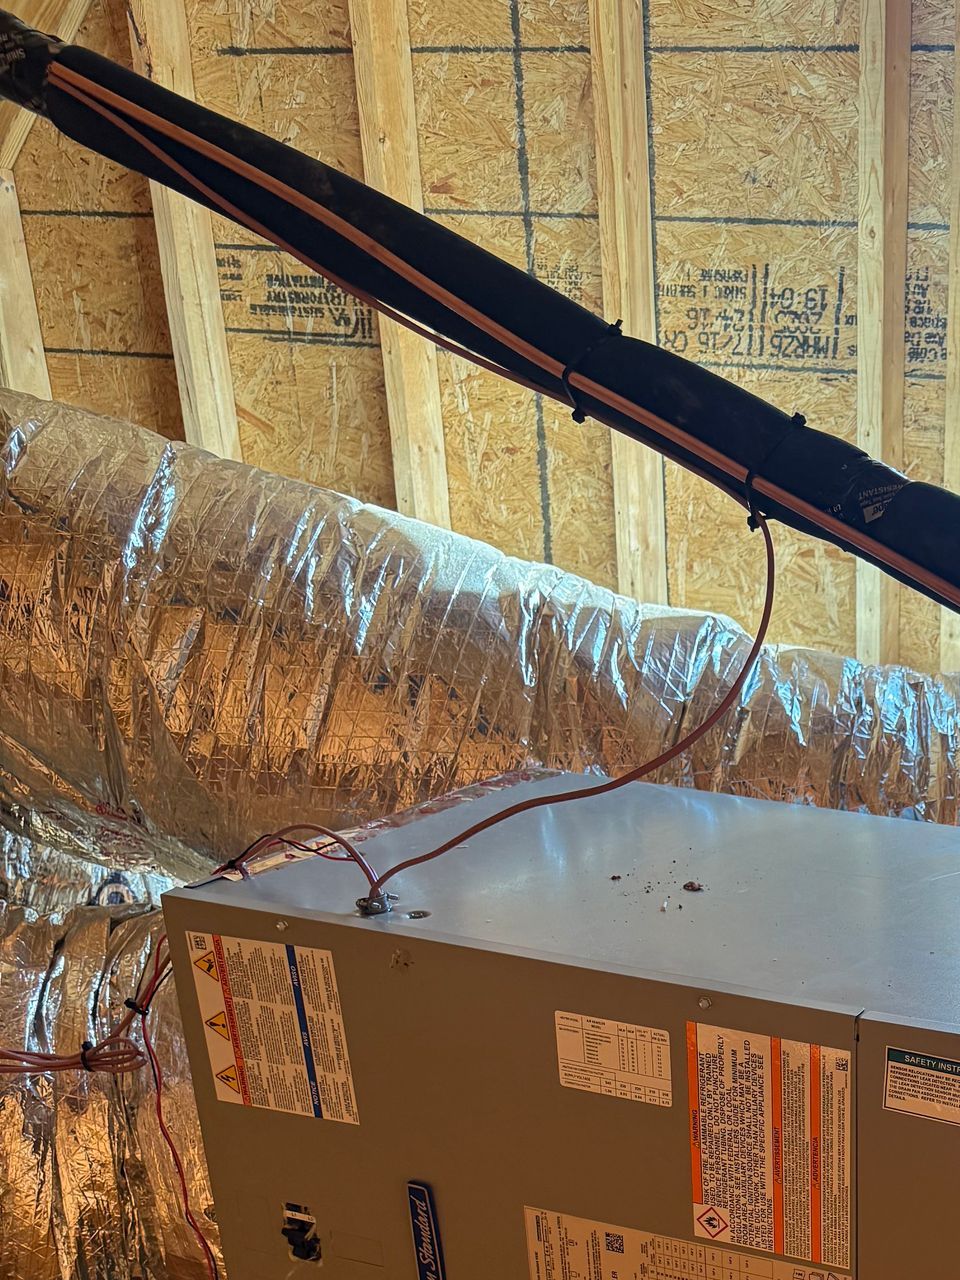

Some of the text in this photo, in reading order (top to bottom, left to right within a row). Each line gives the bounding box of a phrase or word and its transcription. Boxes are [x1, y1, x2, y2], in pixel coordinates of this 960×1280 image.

[266, 291, 324, 304] FORESTRY
[289, 965, 299, 986] AVISO
[301, 1031, 309, 1046] AVIS
[904, 1054, 936, 1068] SAFETY
[238, 1065, 248, 1095] WARNING
[698, 1051, 706, 1106] REFRIGERANT
[738, 1068, 744, 1080] BE
[719, 1078, 724, 1089] OF
[745, 1084, 751, 1095] BE
[309, 1080, 319, 1105] NOTICE
[706, 1087, 712, 1099] BY
[691, 1108, 699, 1142] WARNING
[713, 1114, 719, 1126] DO
[726, 1113, 732, 1126] OR
[709, 1161, 714, 1171] BE
[703, 1176, 708, 1186] OF
[709, 1172, 715, 1183] TO
[410, 1195, 436, 1271] Standard
[730, 1234, 735, 1242] IN
[754, 1240, 760, 1248] IN
